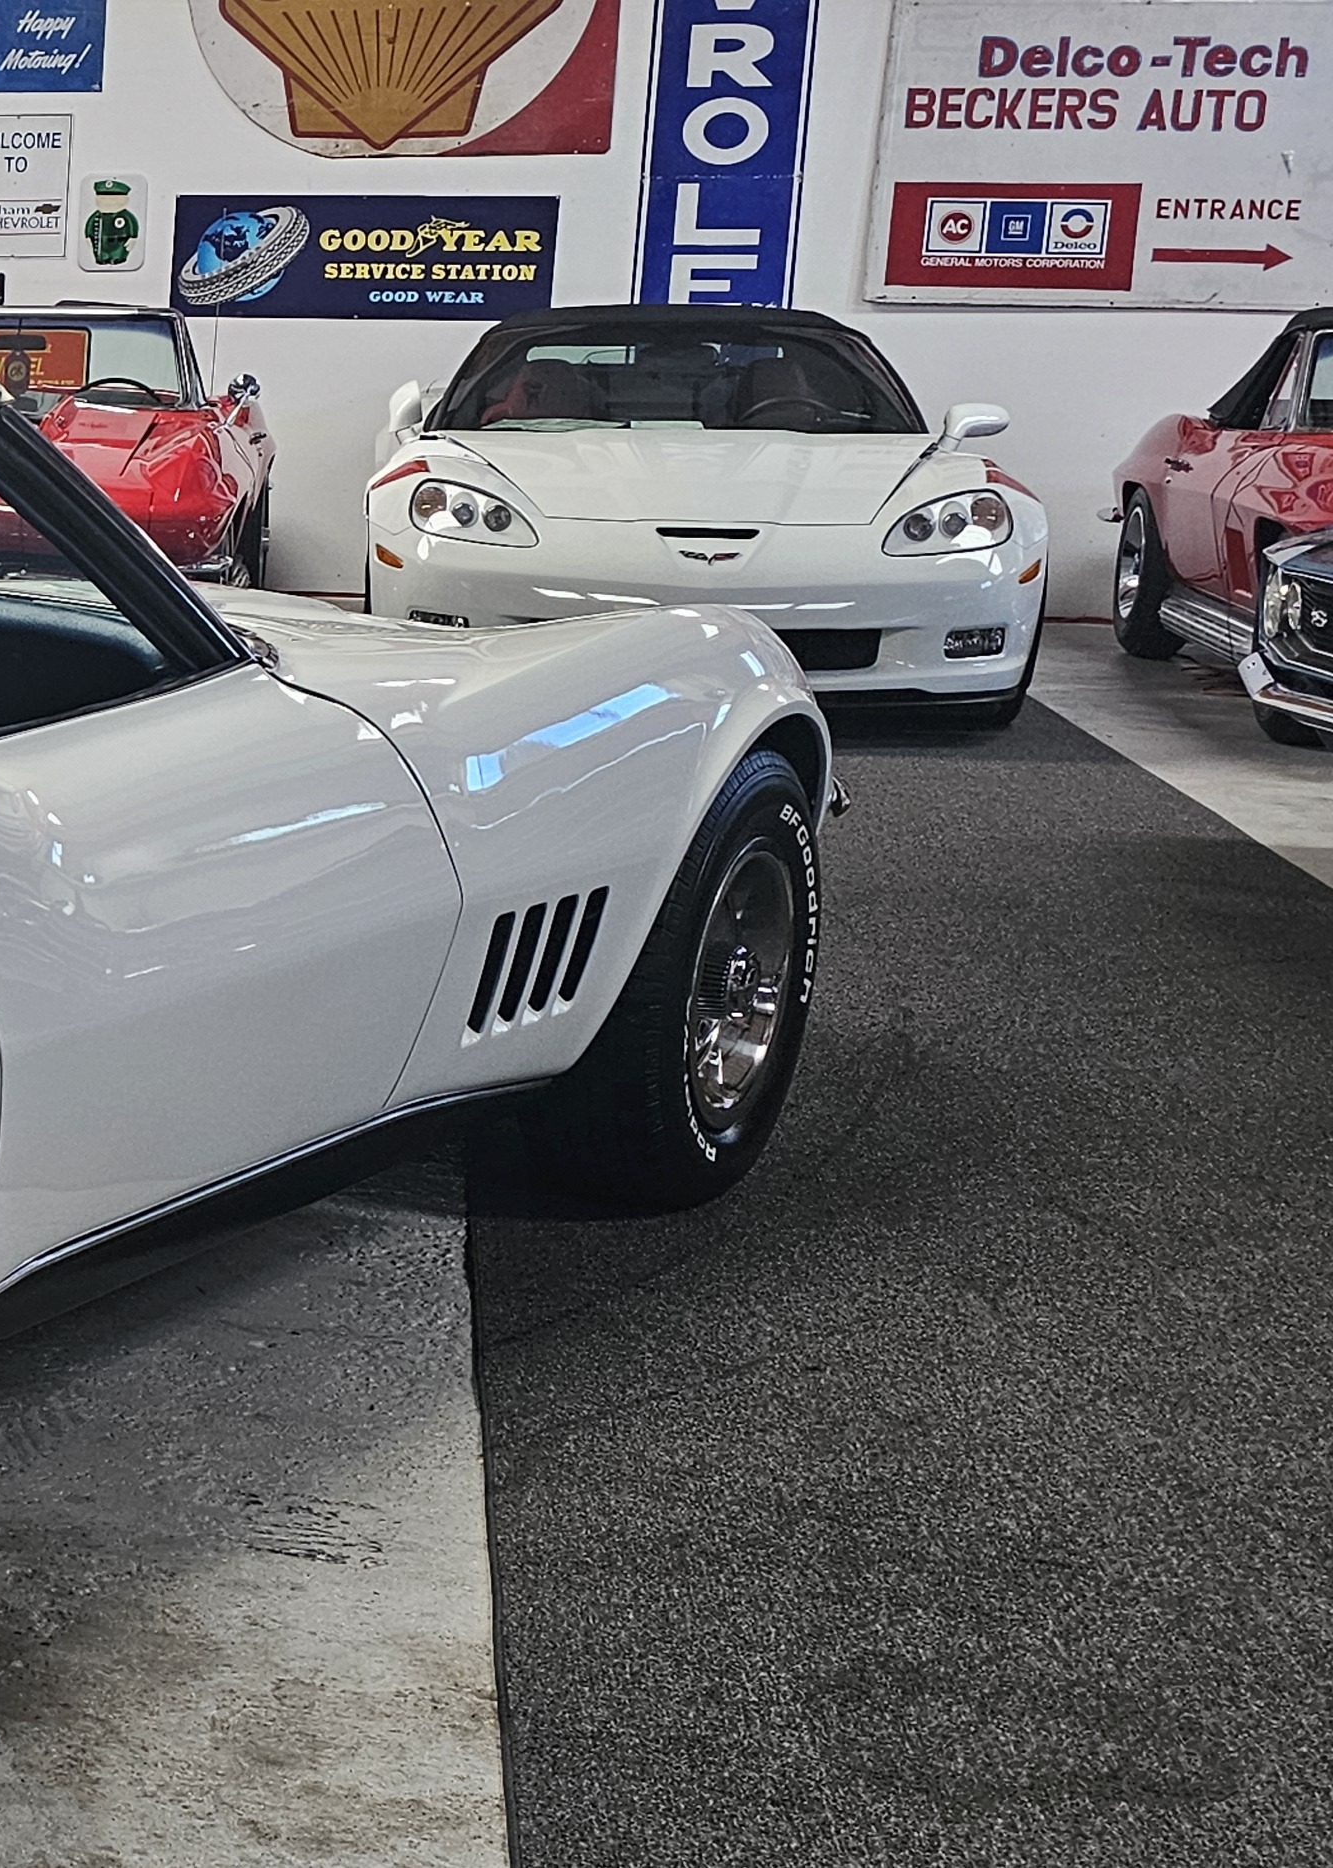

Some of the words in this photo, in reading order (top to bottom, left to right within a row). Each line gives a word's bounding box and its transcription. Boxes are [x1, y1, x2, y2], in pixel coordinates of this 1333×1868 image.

[17, 10, 75, 40] Happy
[0, 44, 92, 75] Motoring!
[904, 88, 1119, 130] BECKERS
[1136, 89, 1267, 131] AUTO
[668, 0, 774, 305] ROLE
[4, 157, 28, 172] TO
[1156, 198, 1302, 221] ENTRANCE
[942, 219, 969, 234] AC
[1008, 220, 1025, 232] GM
[1053, 241, 1097, 251] Delco
[920, 256, 972, 267] GENERAL
[975, 257, 1024, 269] MOTORS
[1025, 258, 1105, 270] CORPORATION
[324, 263, 425, 280] SERVICE
[431, 263, 537, 281] STATION
[369, 290, 419, 303] GOOD
[426, 290, 484, 304] WEAR
